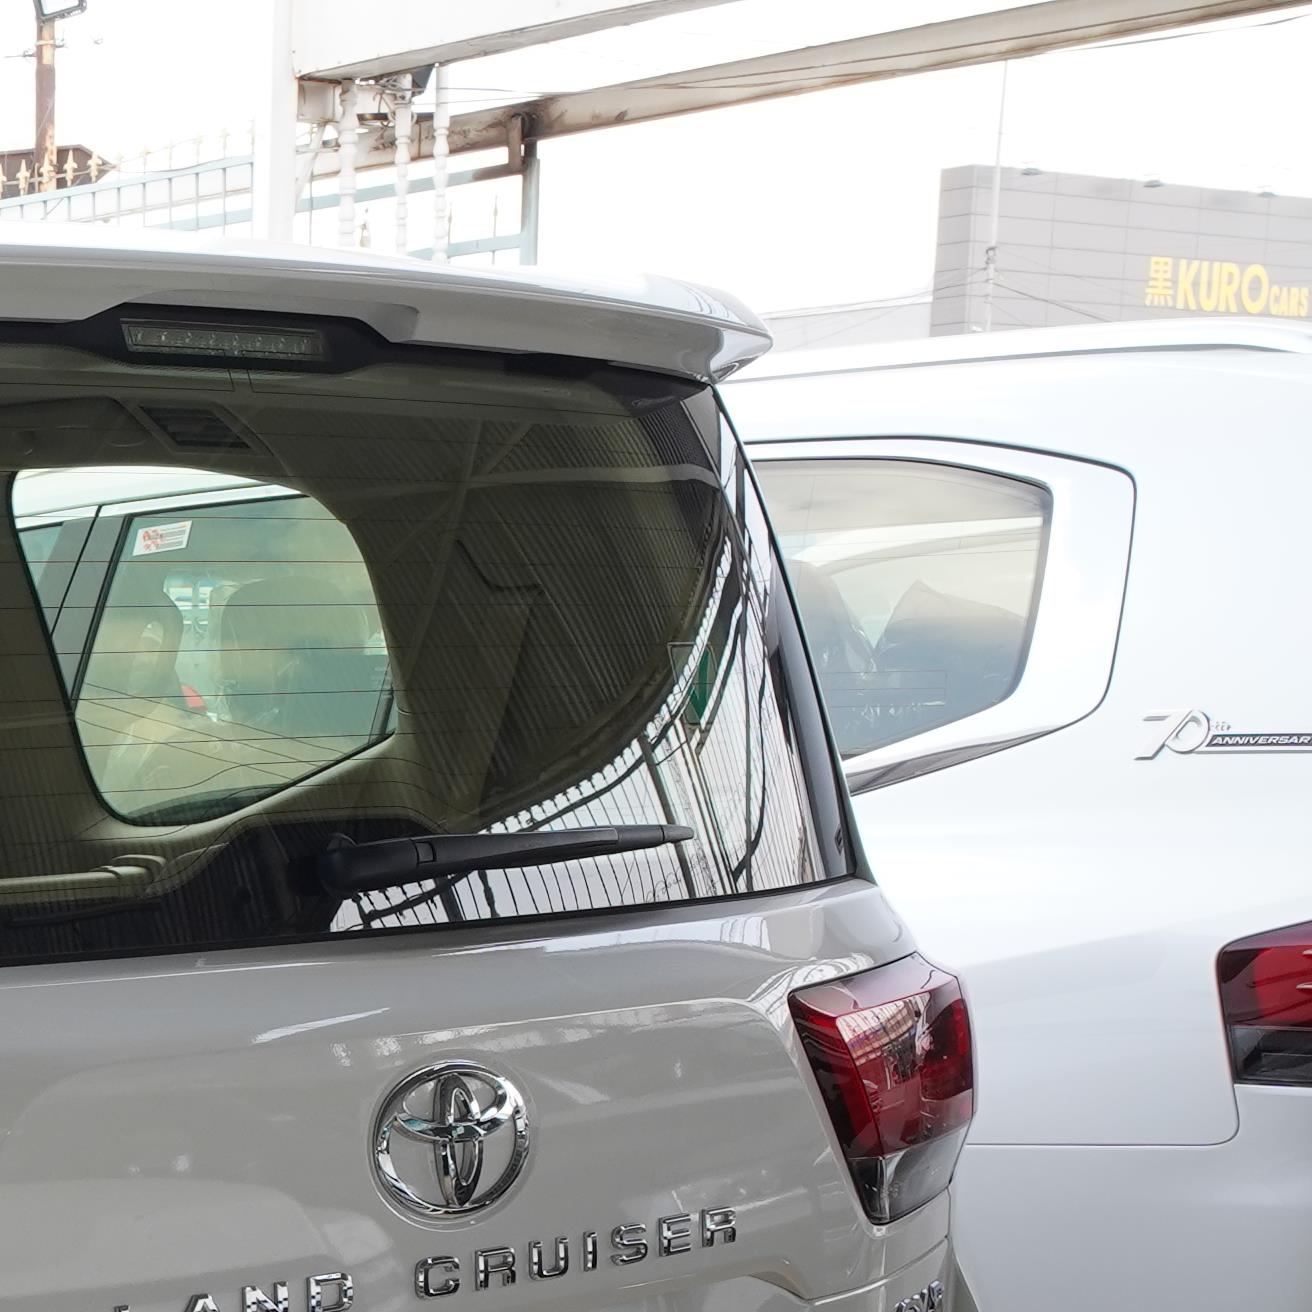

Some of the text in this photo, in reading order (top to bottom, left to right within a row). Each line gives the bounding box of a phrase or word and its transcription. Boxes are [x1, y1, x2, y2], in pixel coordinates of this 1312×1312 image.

[1176, 258, 1309, 317] KURO CARS
[1212, 735, 1312, 745] ANNIVERSAR
[414, 1205, 738, 1300] CRUISER
